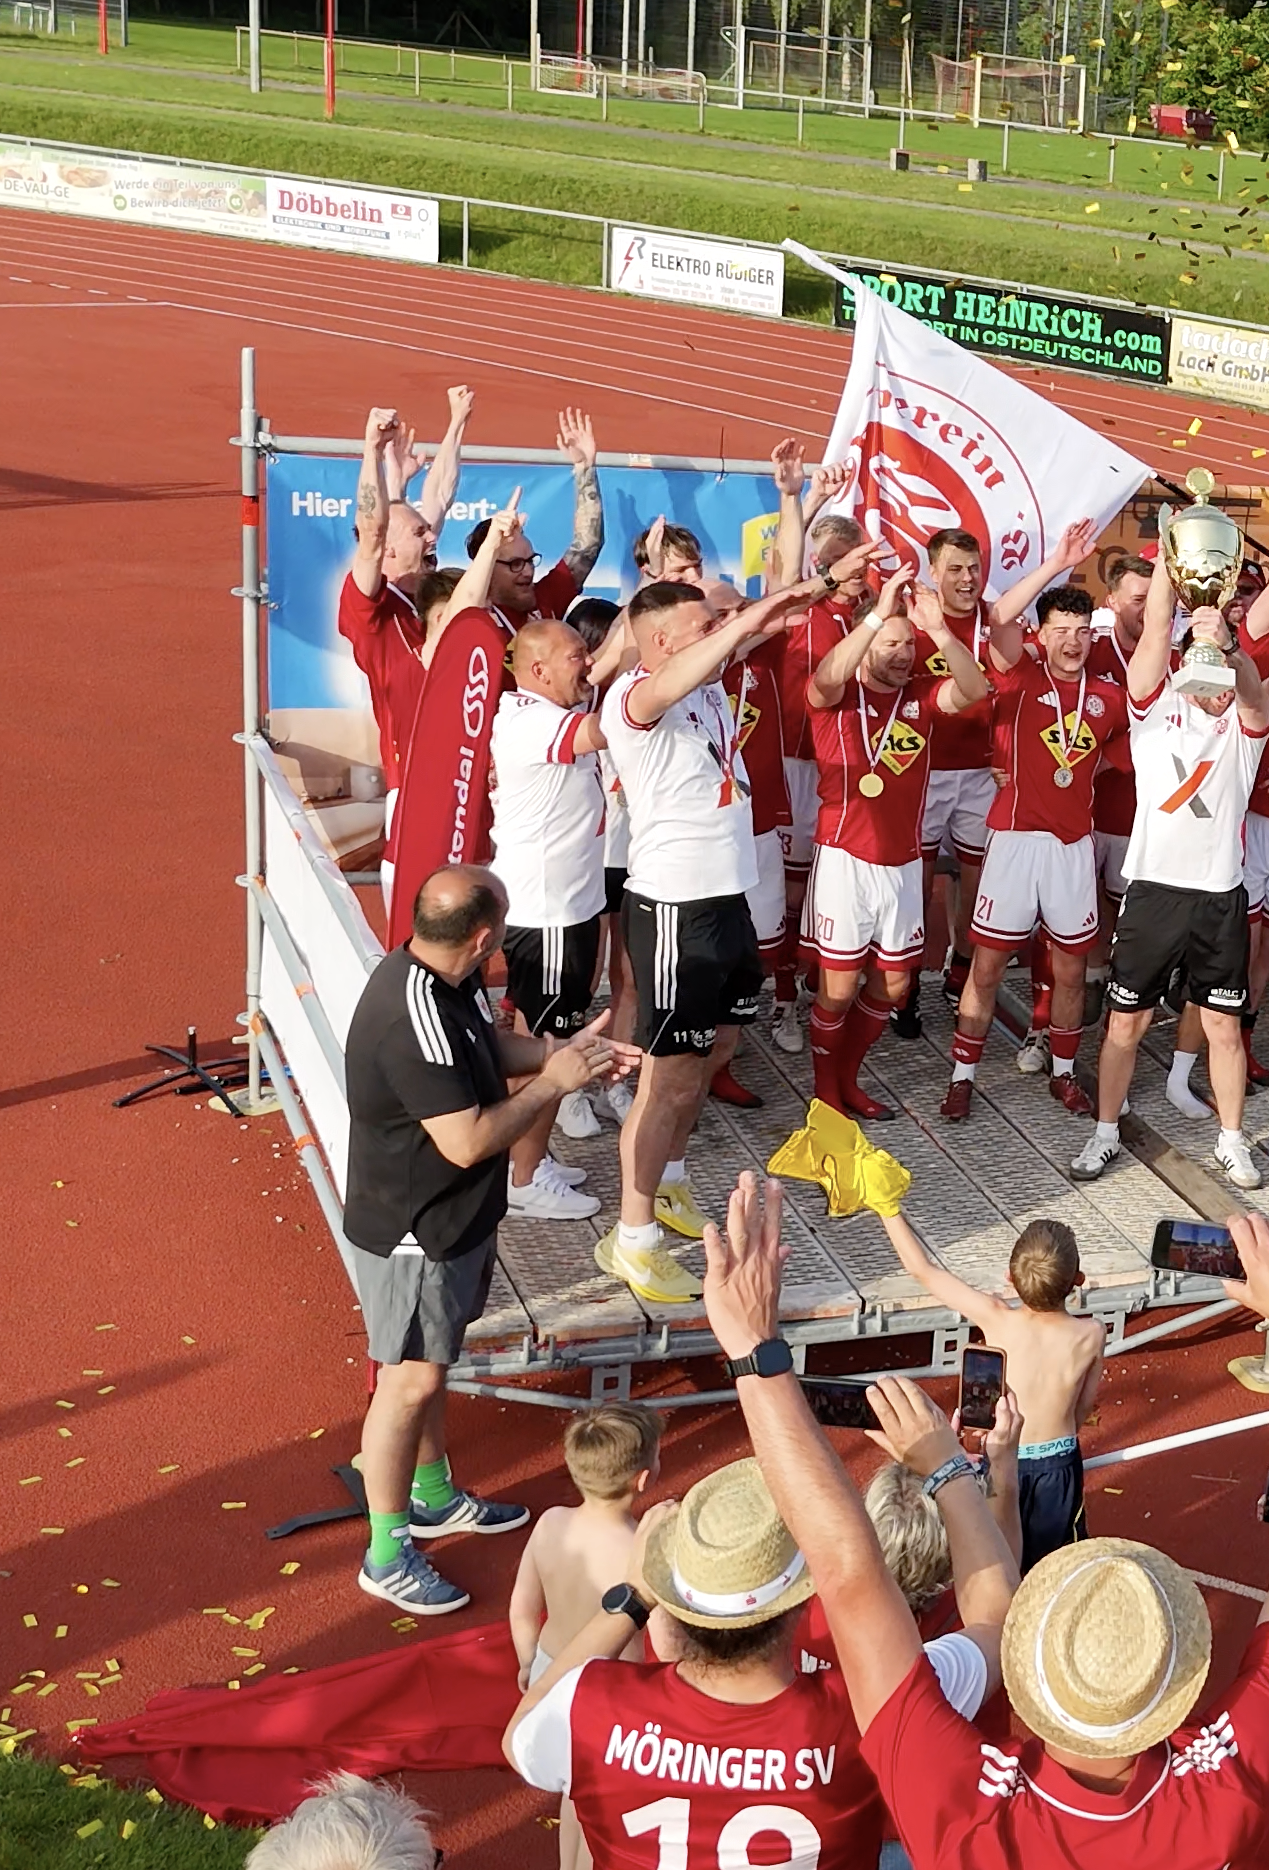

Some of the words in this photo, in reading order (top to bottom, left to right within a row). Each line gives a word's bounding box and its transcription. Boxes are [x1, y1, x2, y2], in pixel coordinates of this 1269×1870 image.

[4, 179, 70, 198] DE-VAU-GE
[114, 179, 149, 190] Werde
[153, 179, 172, 190] ein
[194, 180, 214, 190] von
[130, 198, 171, 209] Bewirb
[278, 190, 383, 223] Döbbelin
[325, 222, 342, 232] UND
[652, 252, 711, 276] ELEKTRO
[716, 259, 775, 286] RÜDIGER
[960, 325, 979, 343] IN
[982, 330, 1162, 376] OSTDEUTSCHLAND
[292, 491, 352, 517] Hier
[448, 745, 474, 864] tendal
[976, 894, 994, 922] 21
[1039, 1437, 1076, 1454] SPACE
[604, 1721, 786, 1791] MÖRINGER
[794, 1744, 836, 1791] SV
